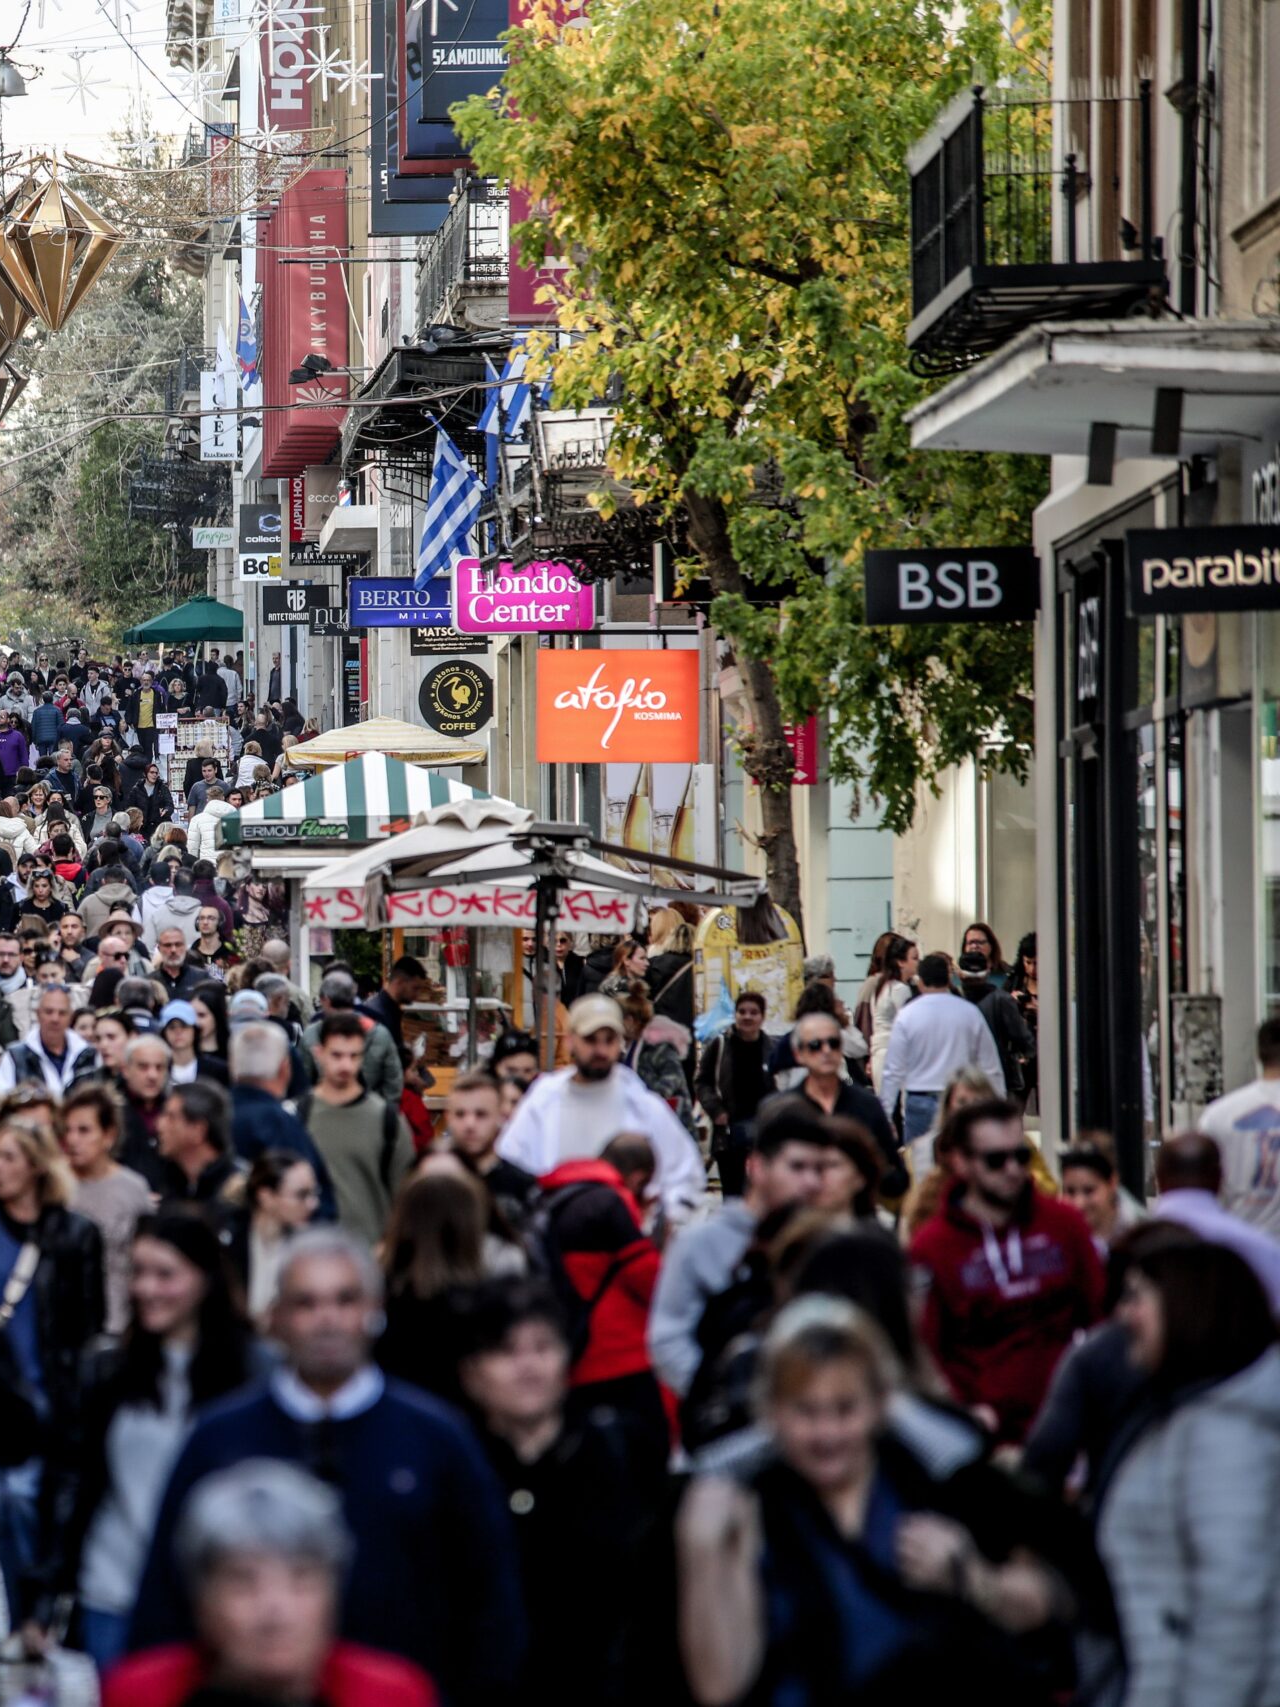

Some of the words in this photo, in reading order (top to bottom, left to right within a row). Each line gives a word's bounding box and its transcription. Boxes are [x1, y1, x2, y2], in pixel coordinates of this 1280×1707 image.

[432, 48, 510, 66] SLAMDUNK.
[308, 494, 338, 503] ecco
[468, 566, 582, 595] Hondos
[898, 560, 1003, 610] BSB
[359, 590, 431, 607] BERTO
[398, 612, 453, 620] MILA
[468, 594, 571, 624] Center
[431, 666, 460, 690] mykonos
[464, 667, 484, 689] charm
[432, 701, 461, 720] mykonos
[464, 700, 482, 718] charm
[633, 711, 683, 721] KOSMIMA
[439, 722, 477, 731] COFFEE
[242, 826, 298, 838] ERMOU
[297, 819, 348, 836] Flower
